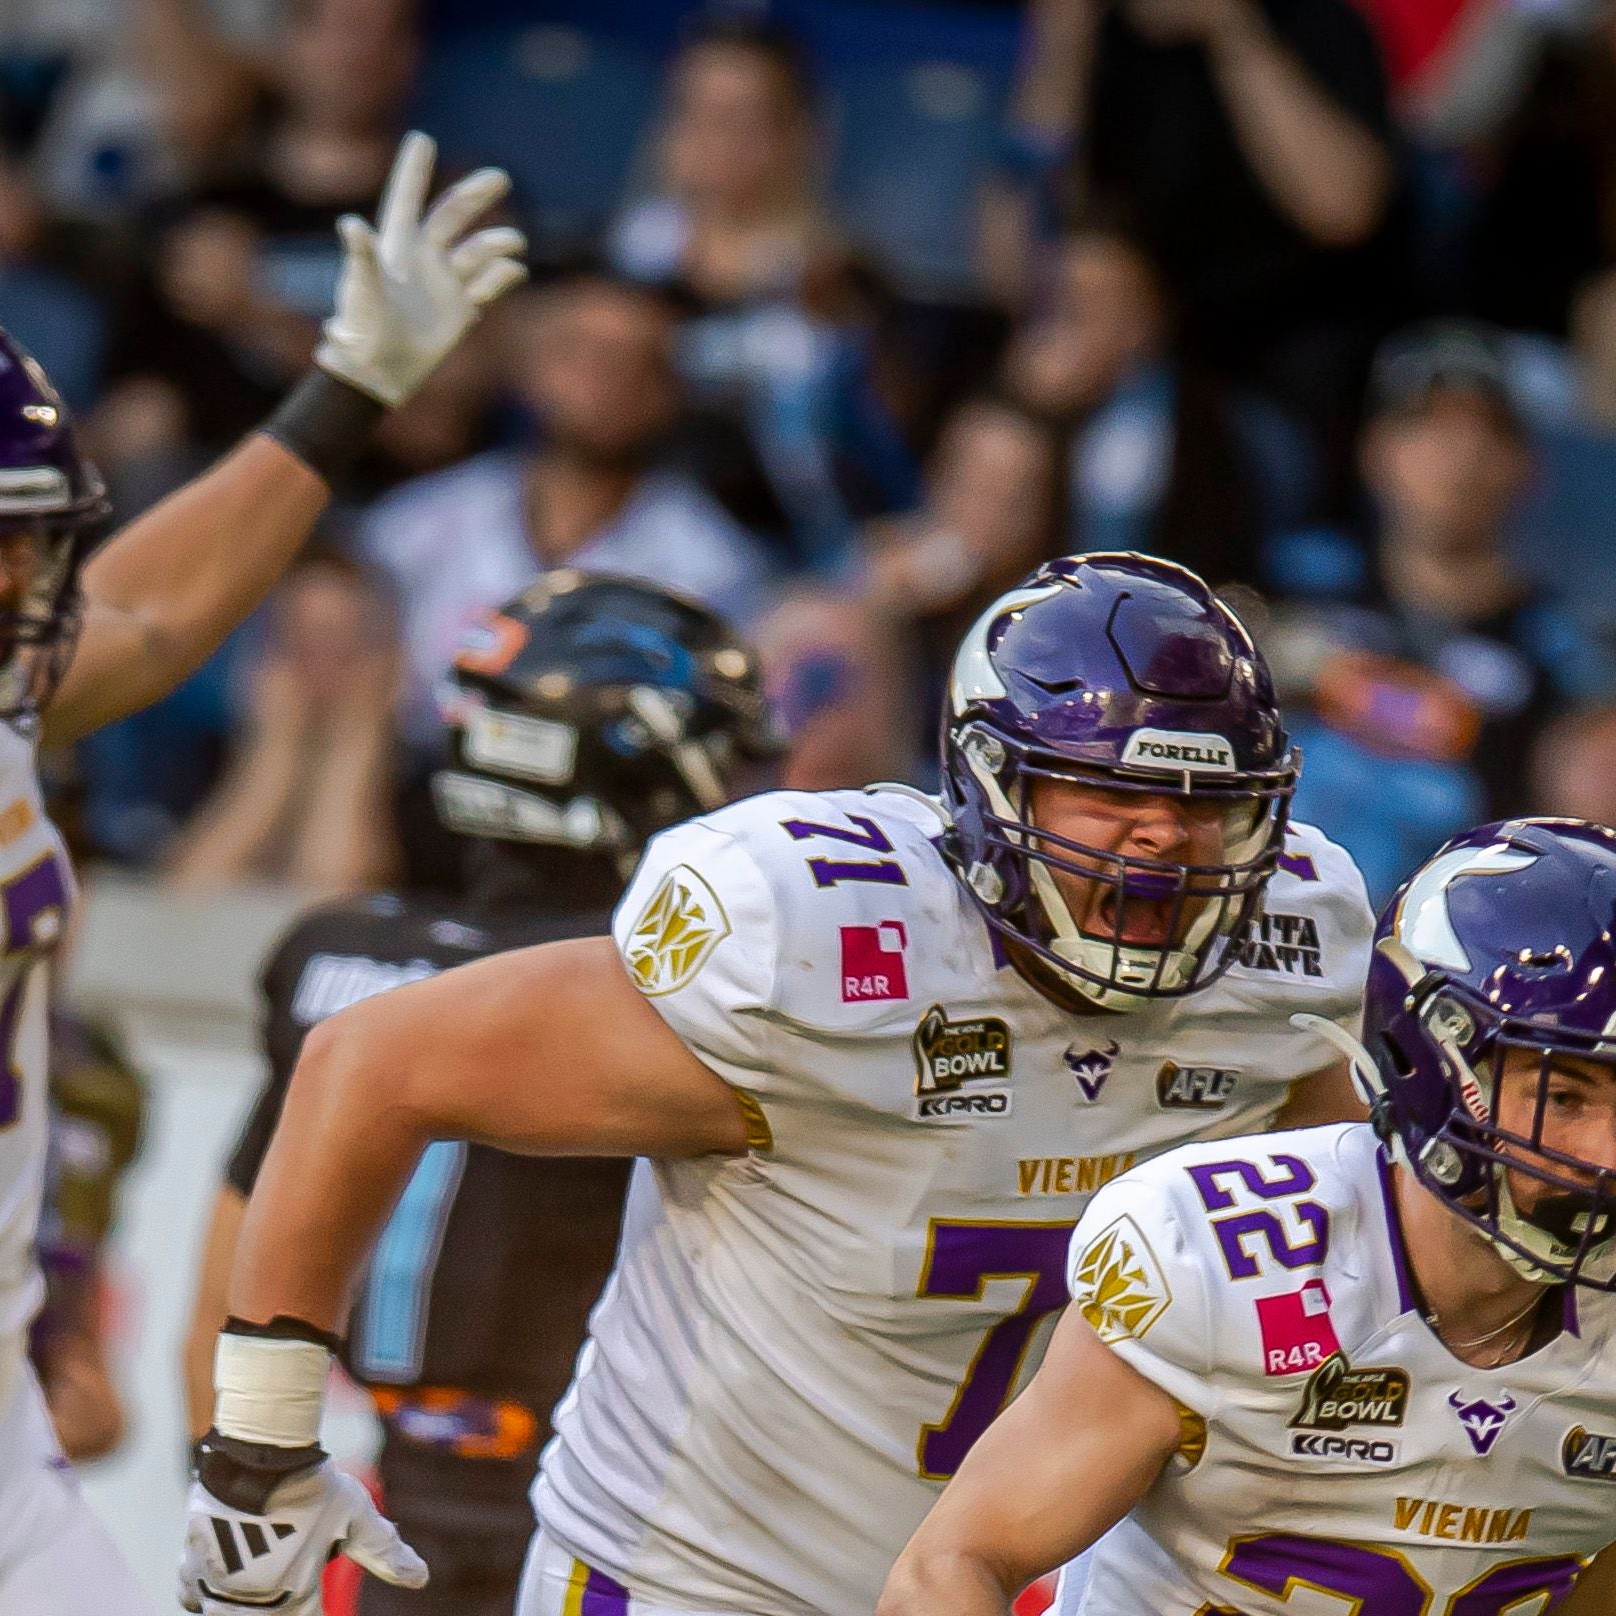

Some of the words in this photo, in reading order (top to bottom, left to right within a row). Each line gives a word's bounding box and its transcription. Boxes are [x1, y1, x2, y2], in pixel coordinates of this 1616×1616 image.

[778, 812, 910, 889] 71
[844, 975, 891, 997] R4R
[935, 1052, 1005, 1078] BOWL
[1164, 1067, 1238, 1103] AFLE
[1183, 1153, 1333, 1282] 22
[1267, 1340, 1325, 1373] R4R
[1317, 1400, 1399, 1422] BOWL
[1393, 1496, 1537, 1544] VIENNA
